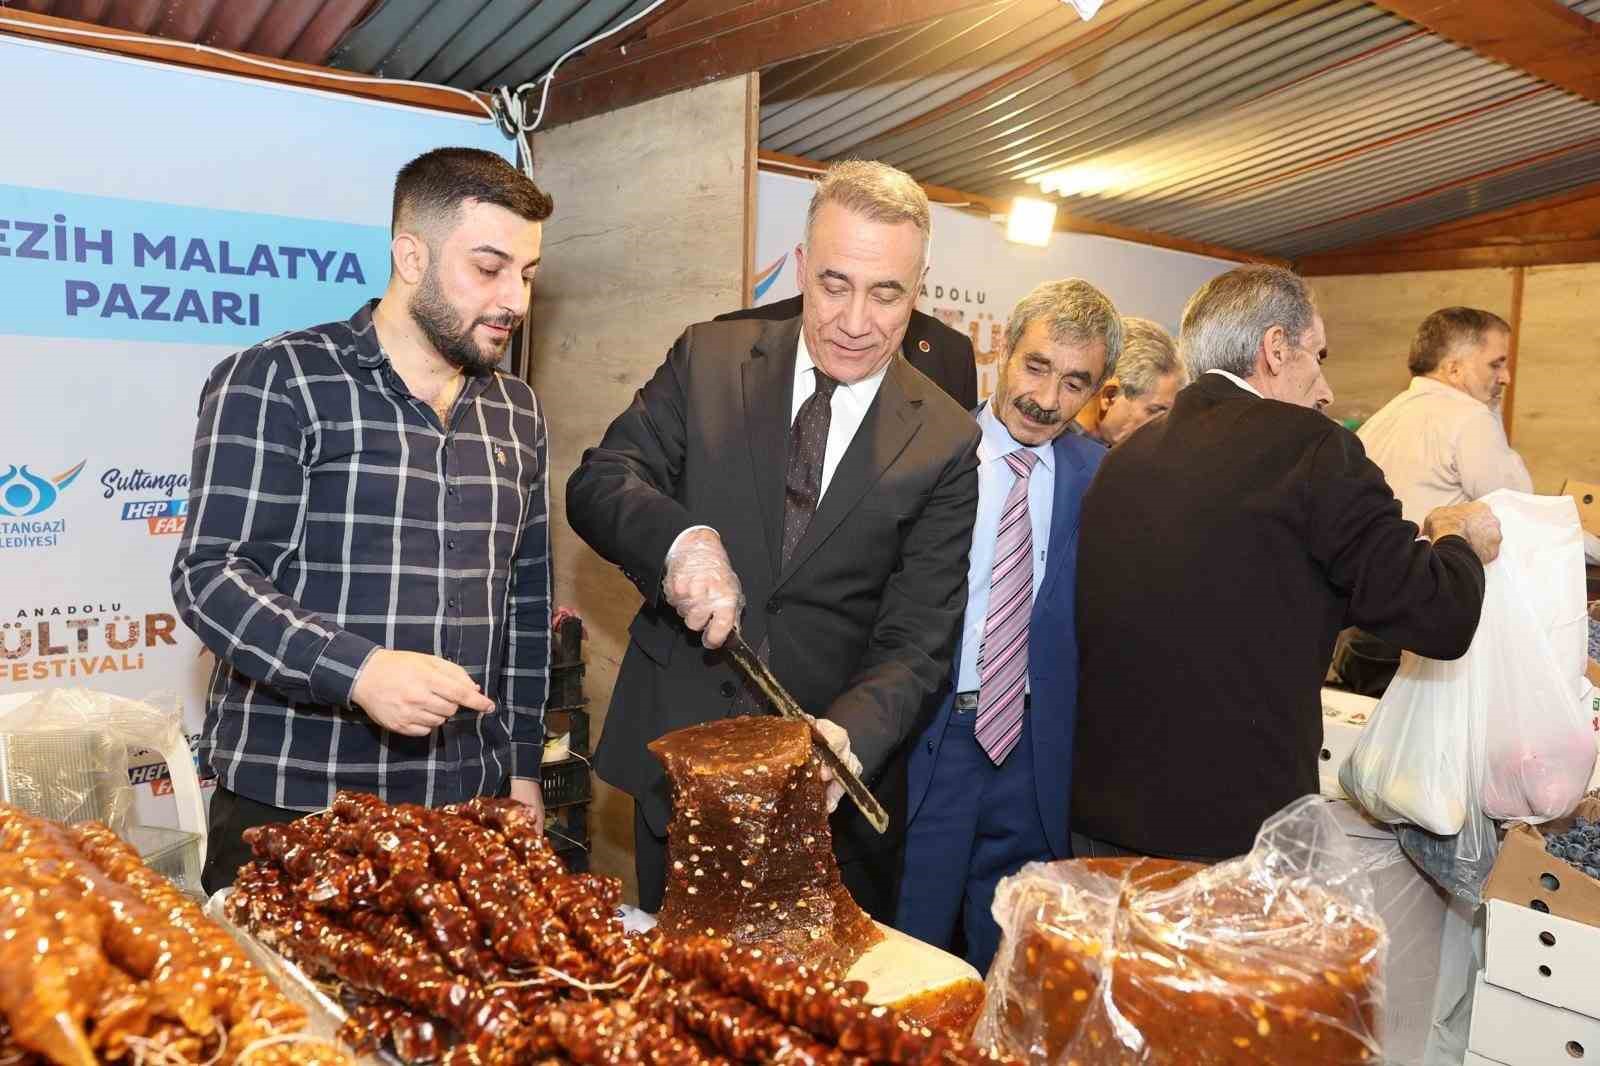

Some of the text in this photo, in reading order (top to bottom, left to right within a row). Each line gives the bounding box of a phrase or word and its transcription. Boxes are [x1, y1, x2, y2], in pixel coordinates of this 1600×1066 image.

[133, 232, 366, 285] MALATYA
[64, 279, 260, 326] PAZARI
[100, 468, 189, 499] Sultanga
[126, 502, 168, 519] HEP
[0, 518, 65, 534] TANGAZİ
[17, 603, 121, 618] ANADOLU
[131, 764, 169, 785] HEP
